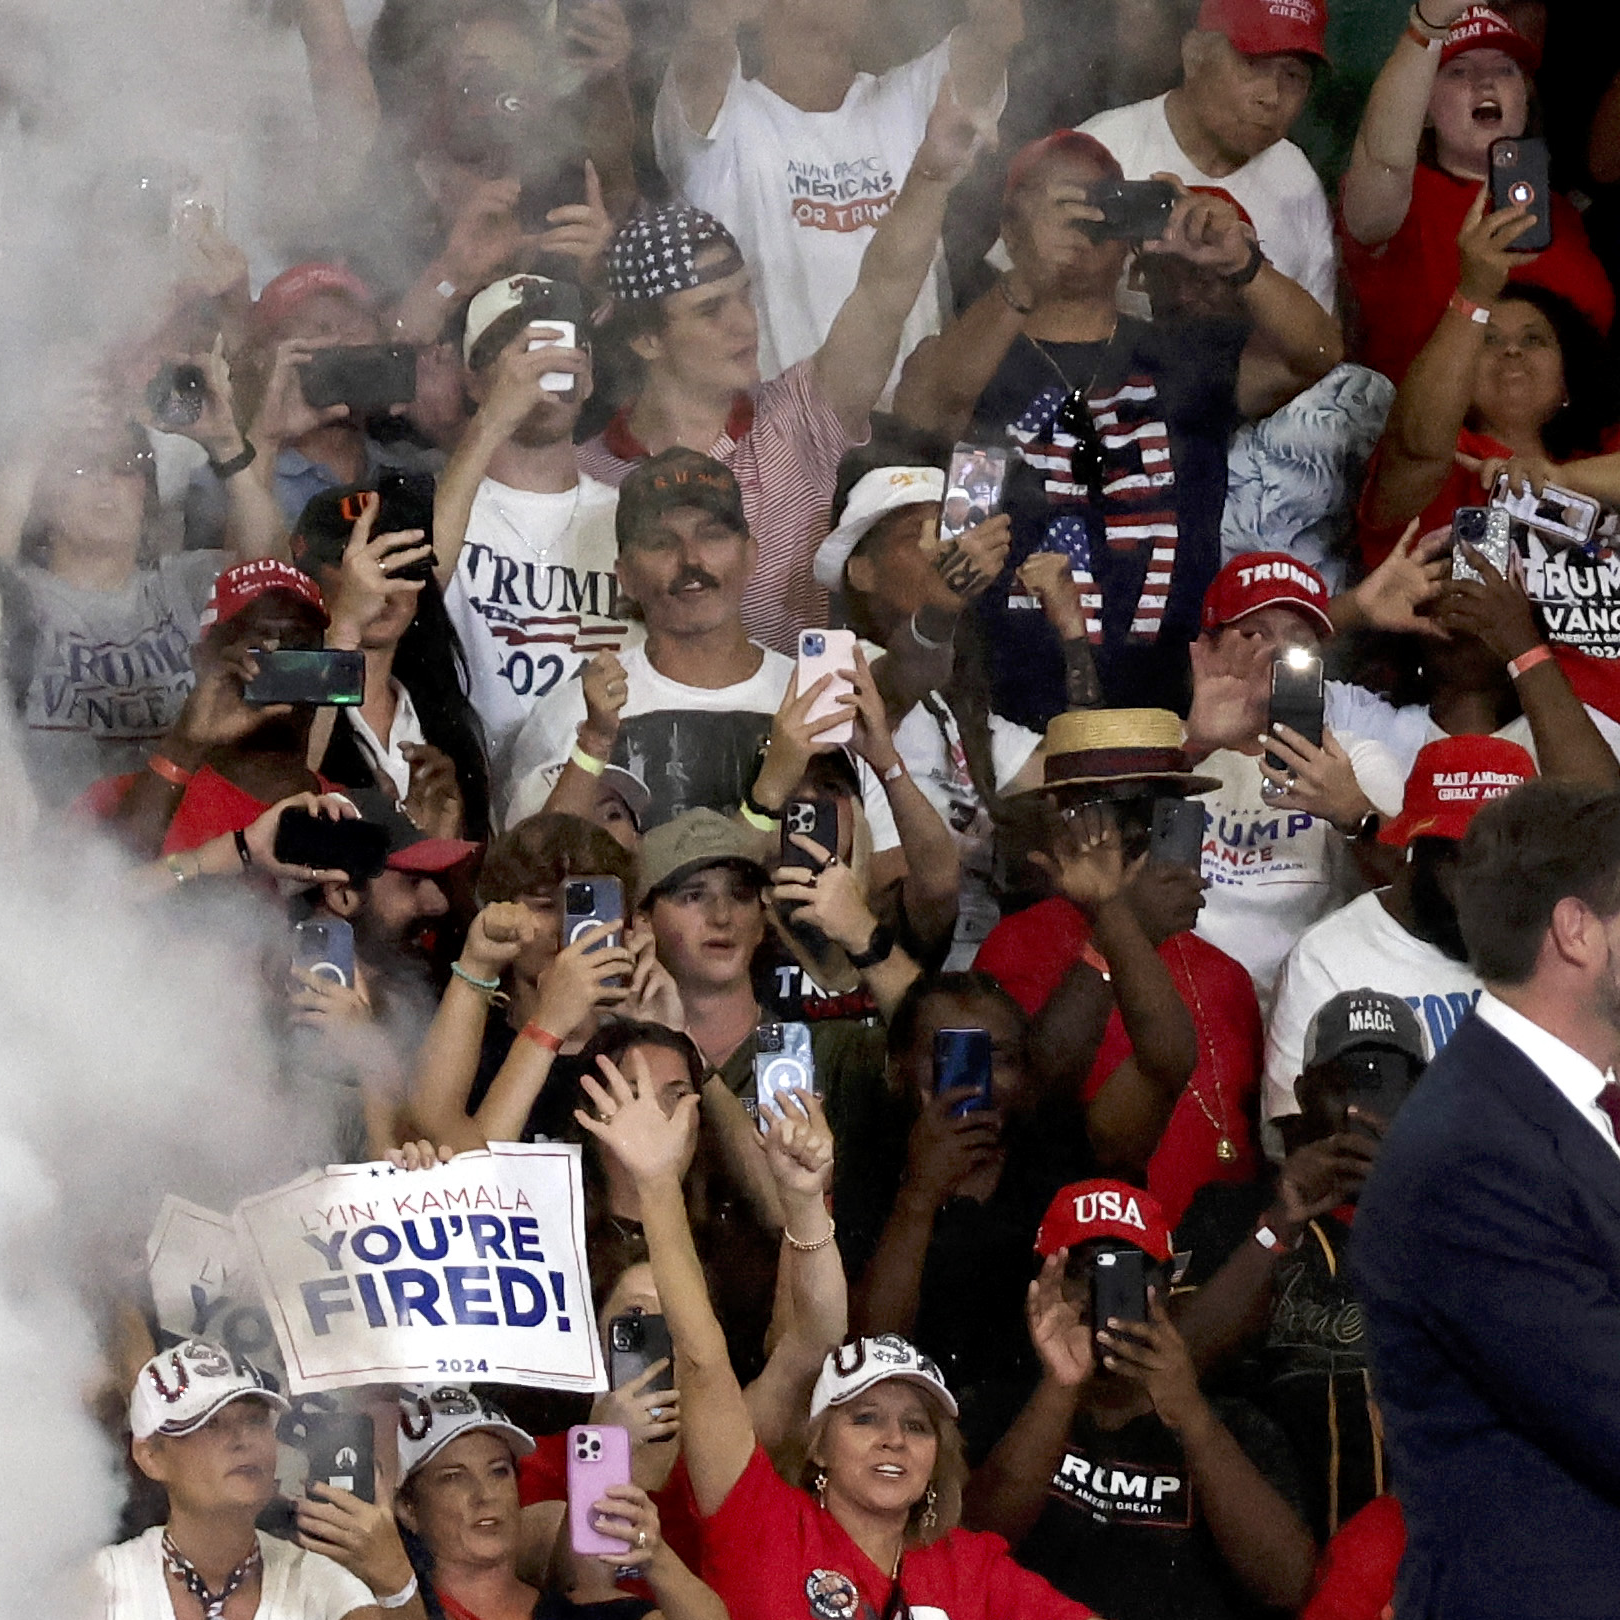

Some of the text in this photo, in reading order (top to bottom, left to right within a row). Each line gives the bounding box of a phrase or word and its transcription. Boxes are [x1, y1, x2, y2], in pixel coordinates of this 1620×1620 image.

[227, 558, 314, 584] TRUMP
[1236, 561, 1321, 596] TRUMP
[299, 1184, 534, 1232] LYIN' KAMALA
[1073, 1190, 1147, 1231] USA
[300, 1213, 546, 1272] YOU'RE
[299, 1265, 572, 1338] FIRED!
[435, 1357, 490, 1374] 2024
